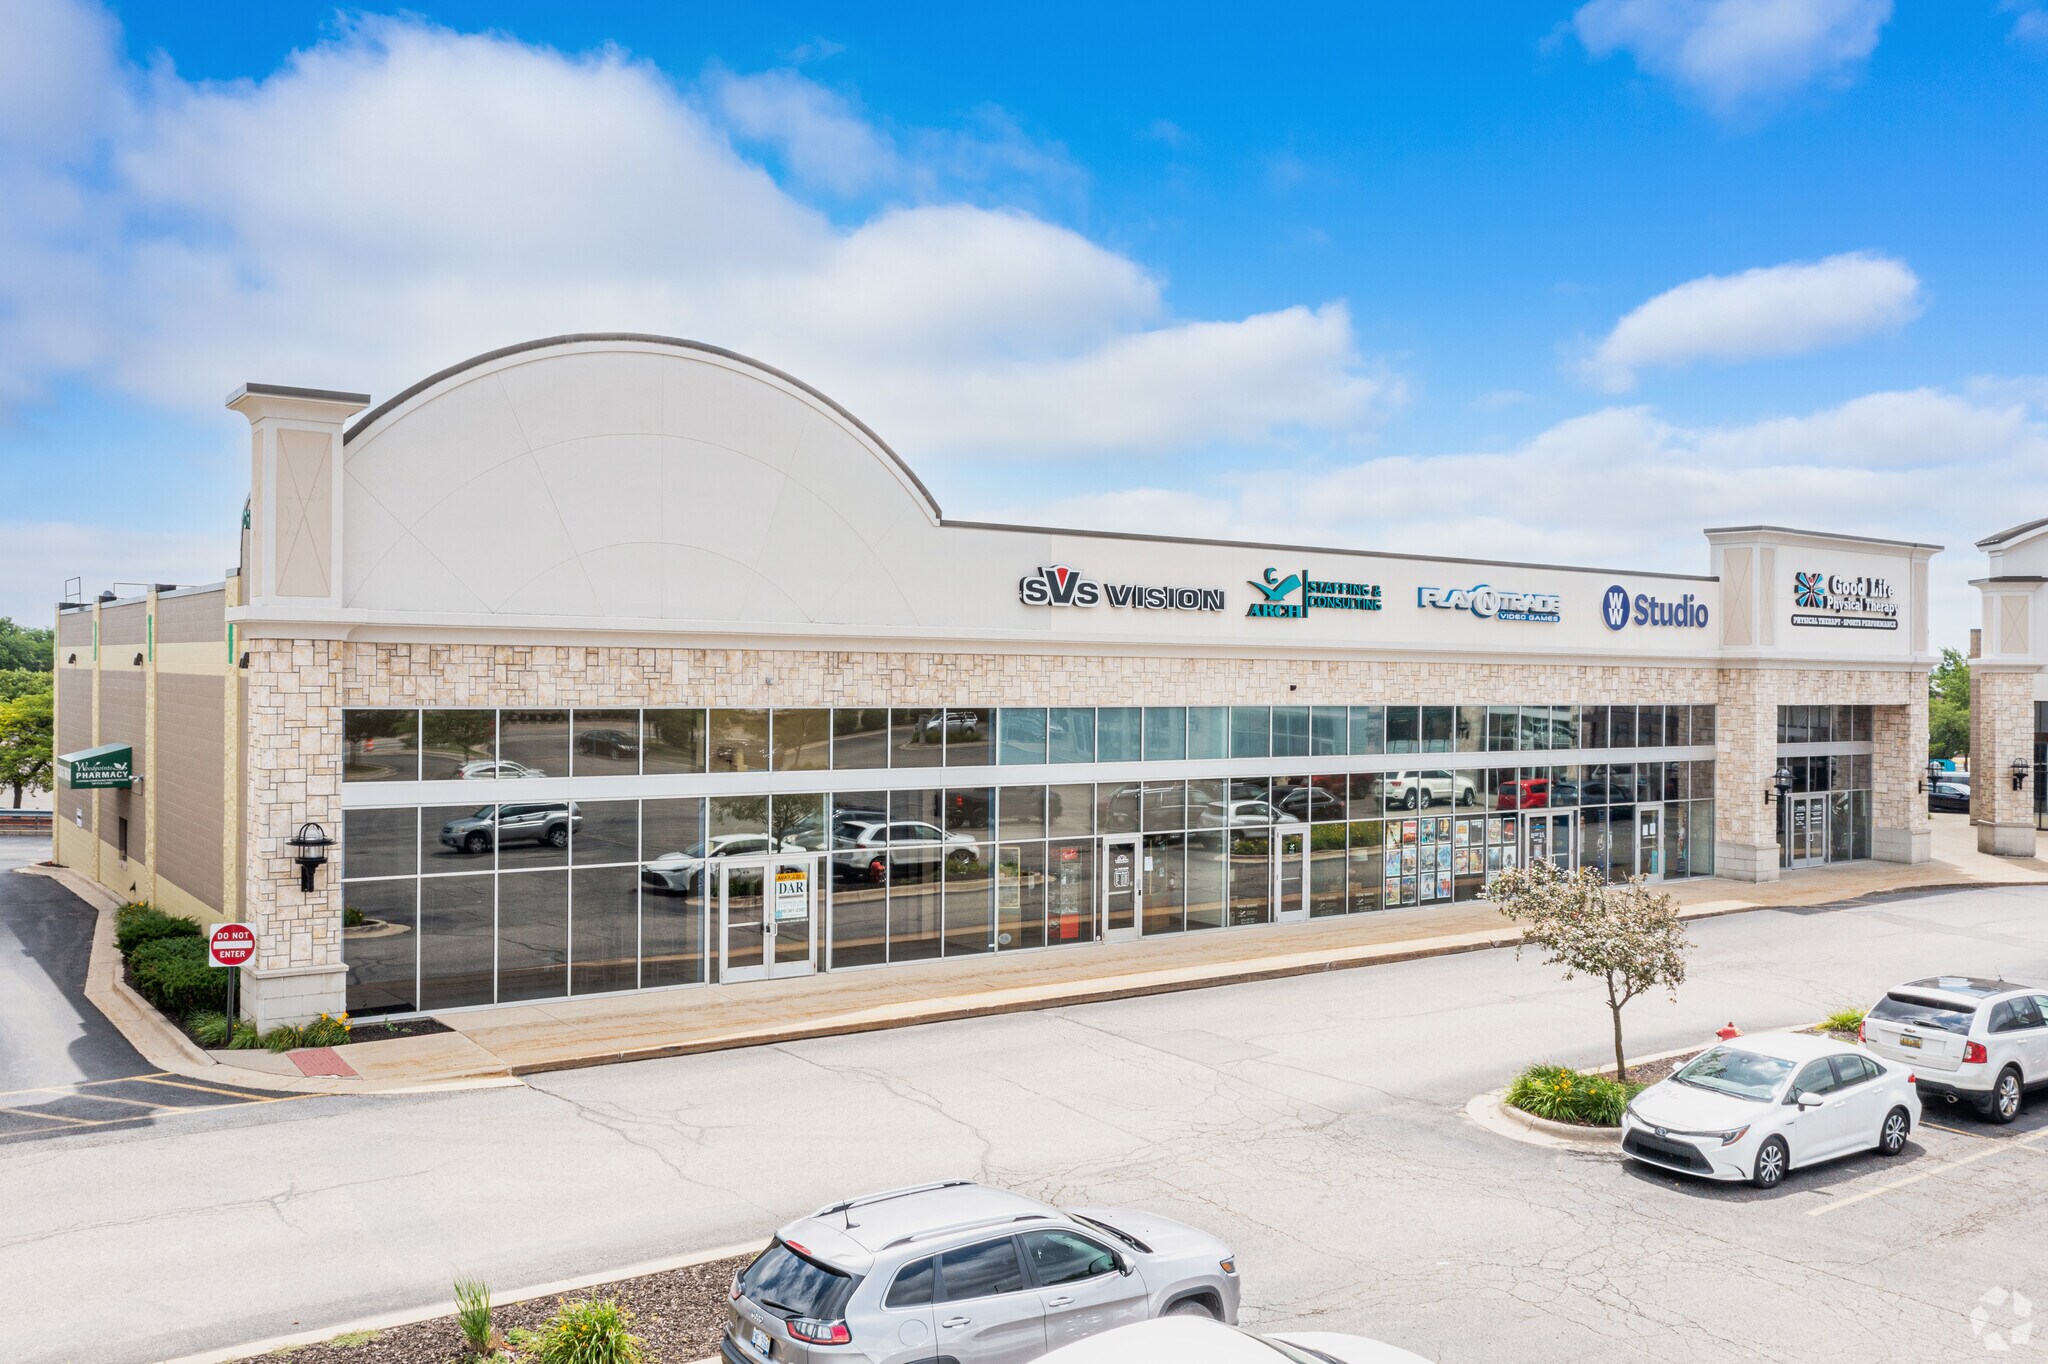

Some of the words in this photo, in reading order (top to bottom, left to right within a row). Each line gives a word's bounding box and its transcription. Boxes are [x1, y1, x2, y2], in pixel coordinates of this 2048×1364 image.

[1309, 580, 1370, 596] STAFFING
[1372, 584, 1382, 597] &
[1830, 575, 1866, 596] Good
[1868, 577, 1895, 599] Life
[1104, 583, 1226, 612] VISION
[1309, 595, 1383, 611] CONSULTING
[1499, 593, 1560, 613] TRADE
[1246, 603, 1303, 618] ARCH
[1633, 593, 1709, 628] Studio
[1825, 595, 1863, 613] Physical
[1865, 598, 1899, 617] Therapy
[1528, 614, 1559, 622] GAMES
[75, 771, 129, 779] PHARMACY
[778, 881, 804, 894] DAR
[232, 931, 249, 939] NOT
[219, 950, 246, 958] ENTER
